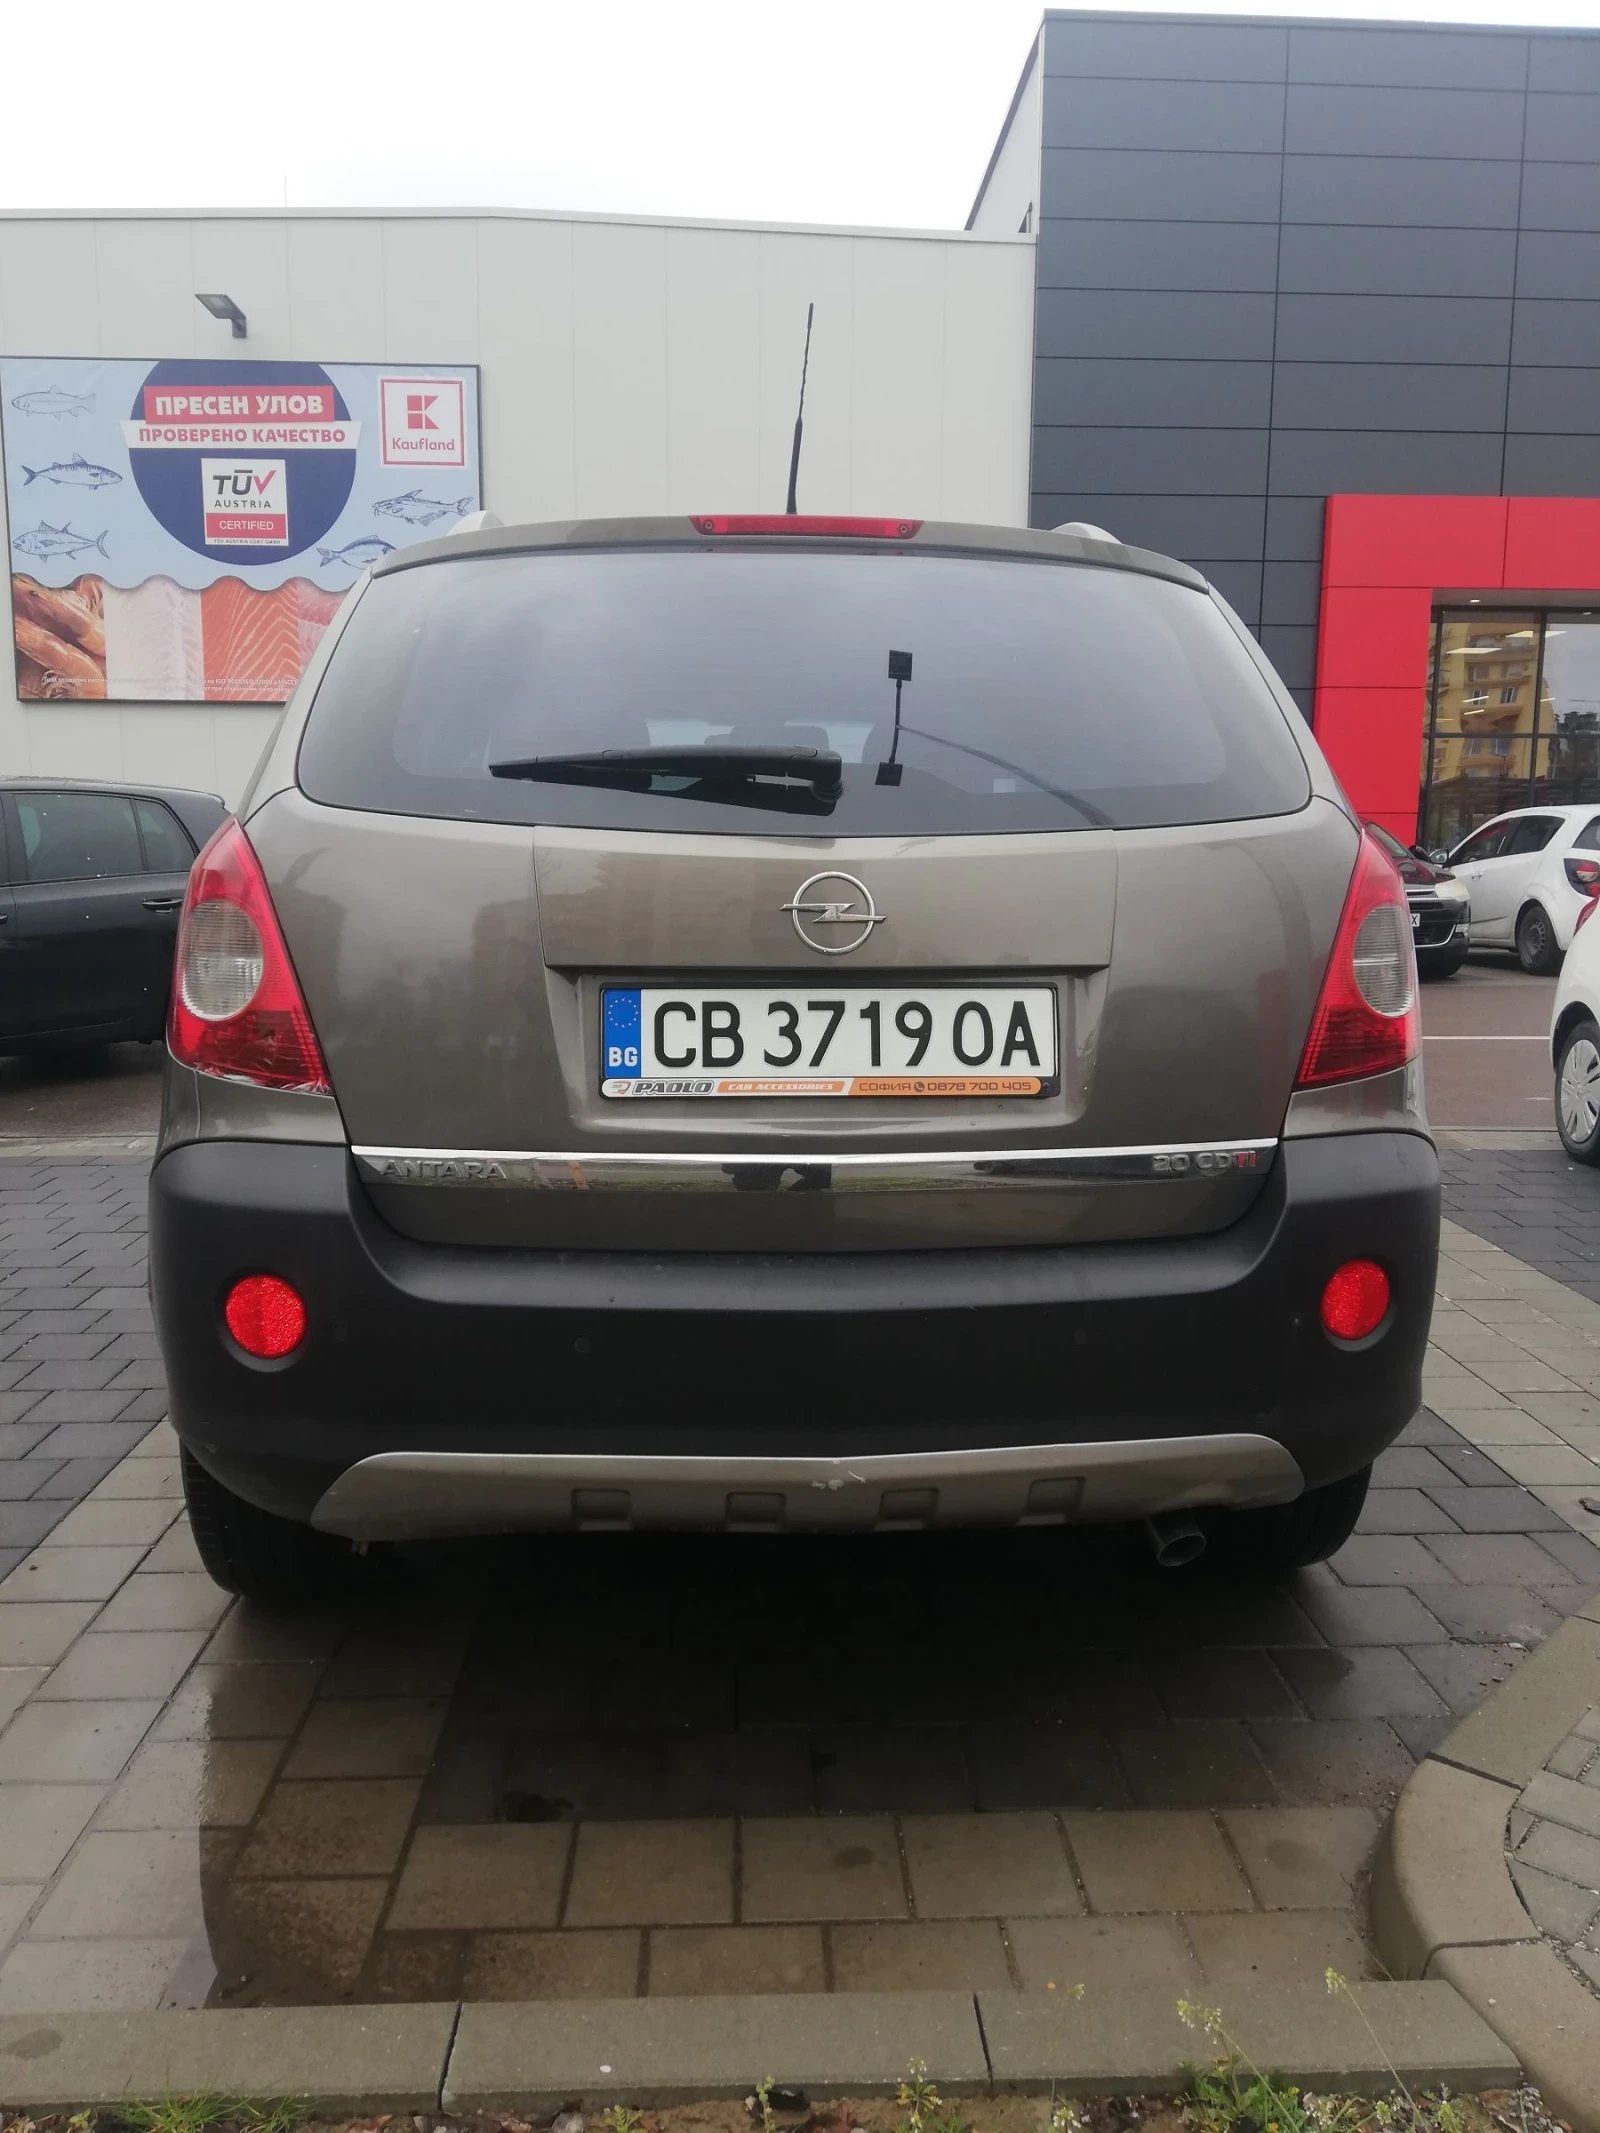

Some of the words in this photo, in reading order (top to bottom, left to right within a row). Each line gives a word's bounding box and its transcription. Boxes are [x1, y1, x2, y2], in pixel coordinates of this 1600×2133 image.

[155, 395, 249, 416] ПРЕСЕН
[255, 394, 323, 415] УЛОВ
[139, 428, 247, 442] ПРОВЕРЕНО
[252, 428, 346, 443] КАЧЕСТВО
[392, 437, 455, 451] Kaufland
[214, 499, 272, 509] AUSTRIA
[219, 520, 274, 531] CERTIFIED
[654, 1001, 744, 1067] CB
[764, 1001, 932, 1067] 3719
[608, 1046, 638, 1067] BG
[632, 1080, 714, 1096] PAOLO
[728, 1083, 759, 1091] CAR
[761, 1083, 834, 1091] ACCESSORIES
[859, 1083, 911, 1092] СОФИЯ
[928, 1082, 965, 1091] 0878
[970, 1082, 998, 1091] 700
[1002, 1082, 1032, 1090] 405
[382, 1159, 507, 1180] ANTARA
